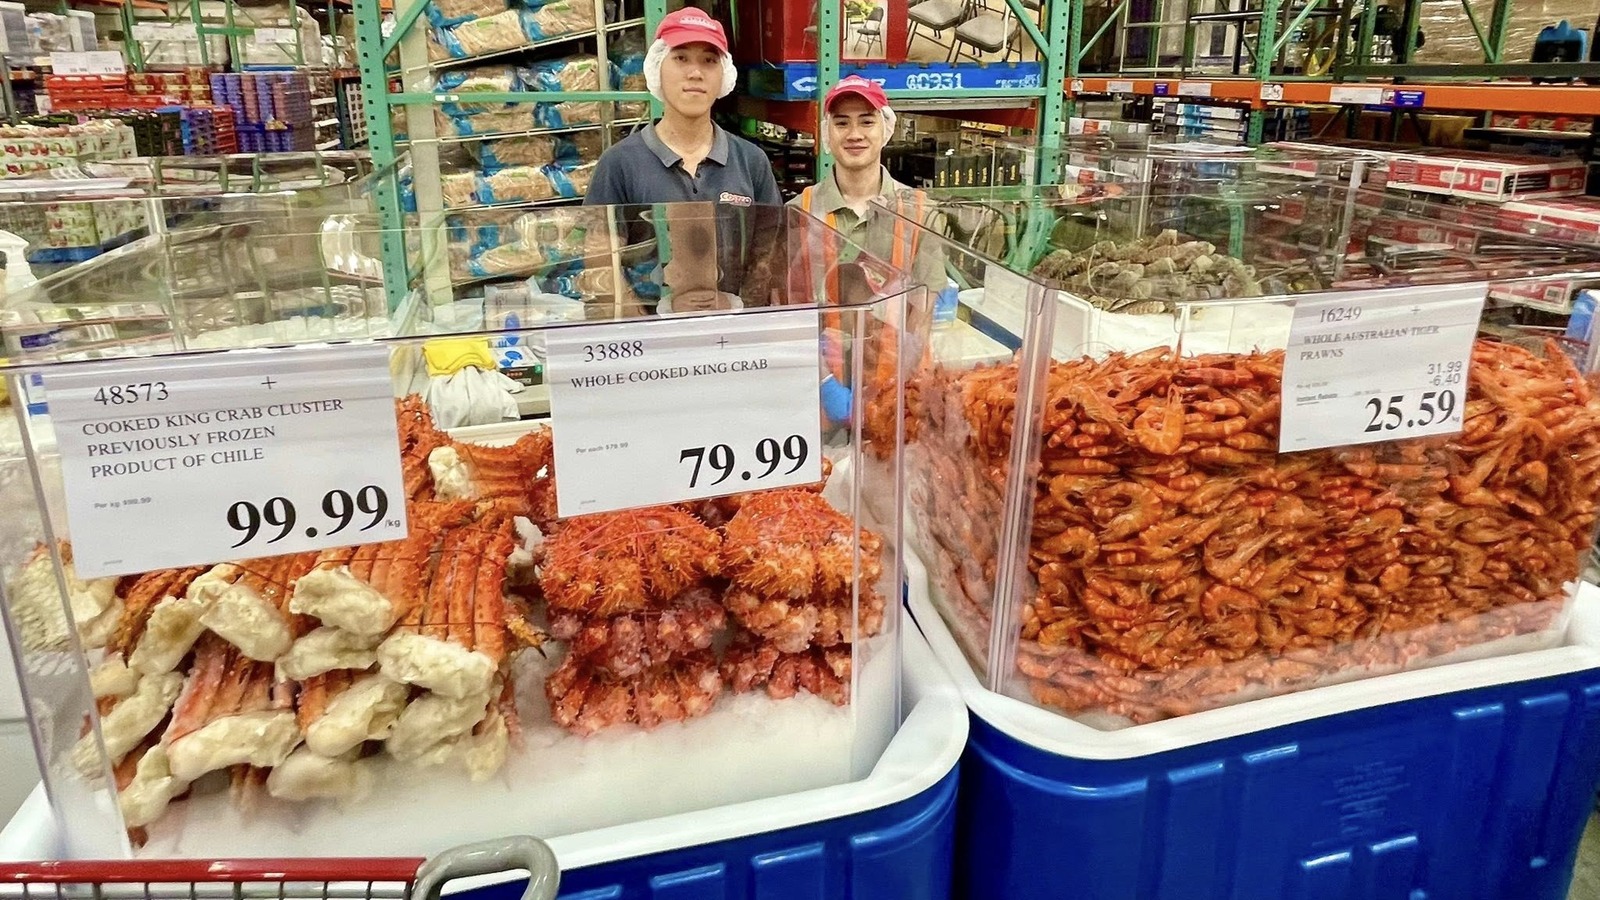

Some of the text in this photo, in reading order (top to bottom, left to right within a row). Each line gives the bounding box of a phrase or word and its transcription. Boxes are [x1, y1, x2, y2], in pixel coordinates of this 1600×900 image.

[1320, 306, 1362, 323] 16249
[1303, 325, 1439, 345] WHOLE AUSTRALIAN TIGER
[583, 340, 644, 363] 33888
[1300, 349, 1344, 361] PRAWNS
[571, 359, 768, 388] WHOLE COOKED KING CRAB
[1427, 361, 1462, 375] 31.99
[1429, 373, 1461, 386] -6.40
[94, 381, 169, 406] 48573
[82, 398, 344, 436] COOKED KING CRAB CLUSTER
[1364, 389, 1455, 433] 25.59
[87, 425, 276, 457] PREVIOUSLY FROZEN
[91, 447, 264, 479] PRODUCT OF CHILE
[679, 434, 808, 488] 79.99
[227, 484, 389, 549] 99.99
